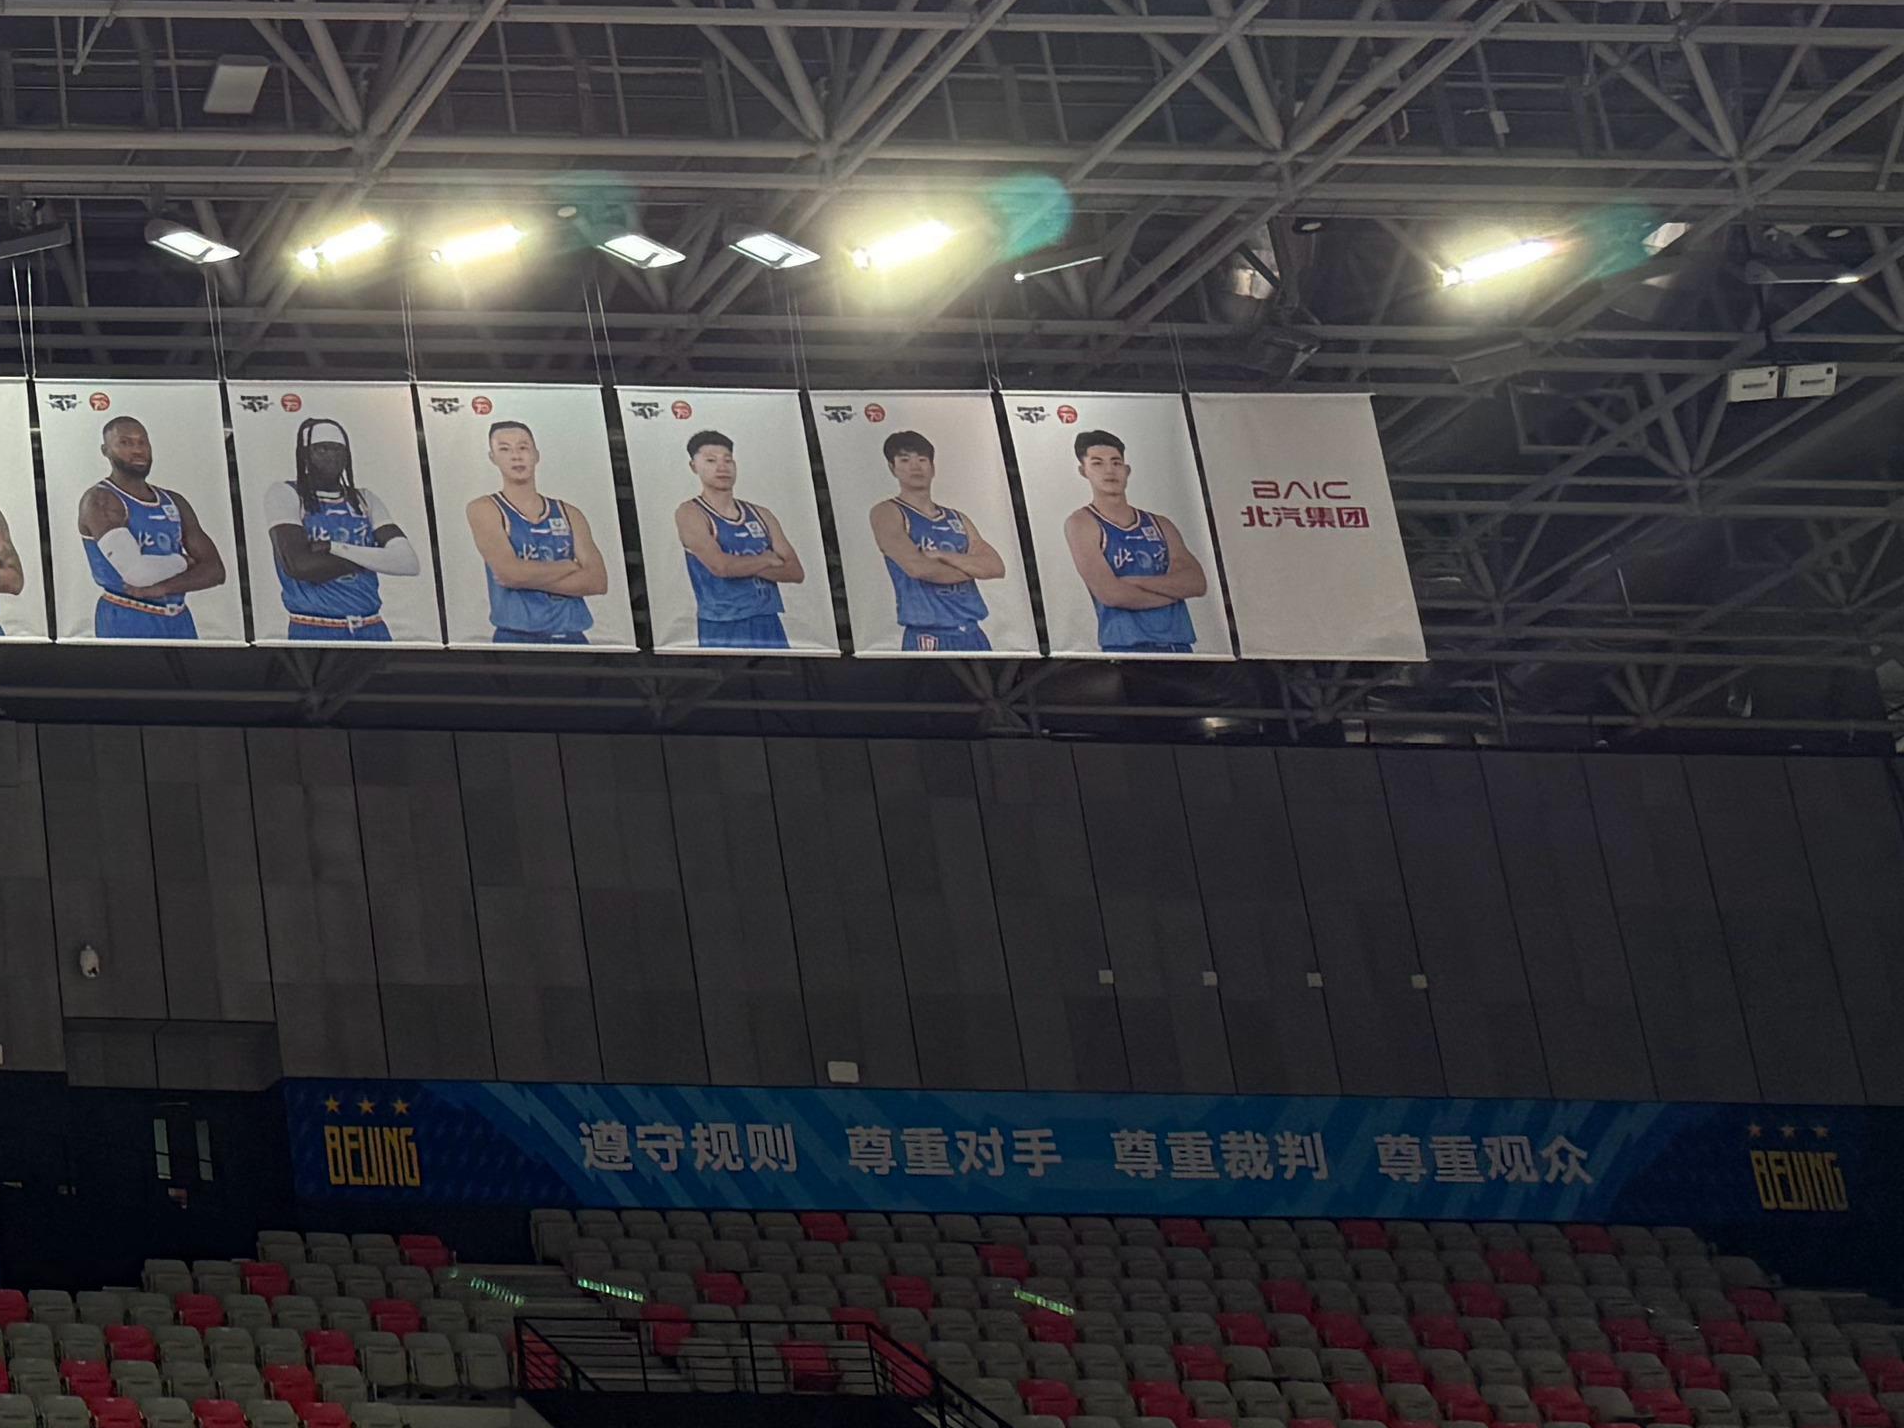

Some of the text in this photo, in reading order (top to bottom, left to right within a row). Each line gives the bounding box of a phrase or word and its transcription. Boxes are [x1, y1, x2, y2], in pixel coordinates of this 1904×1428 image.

[1241, 506, 1370, 528] 北汽集团
[1251, 481, 1351, 499] BAIC
[323, 1125, 421, 1187] BEIJING
[578, 1122, 1594, 1186] 遵守规则 尊重对手 尊重裁判 尊重观众
[1749, 1149, 1850, 1212] BEIJING
